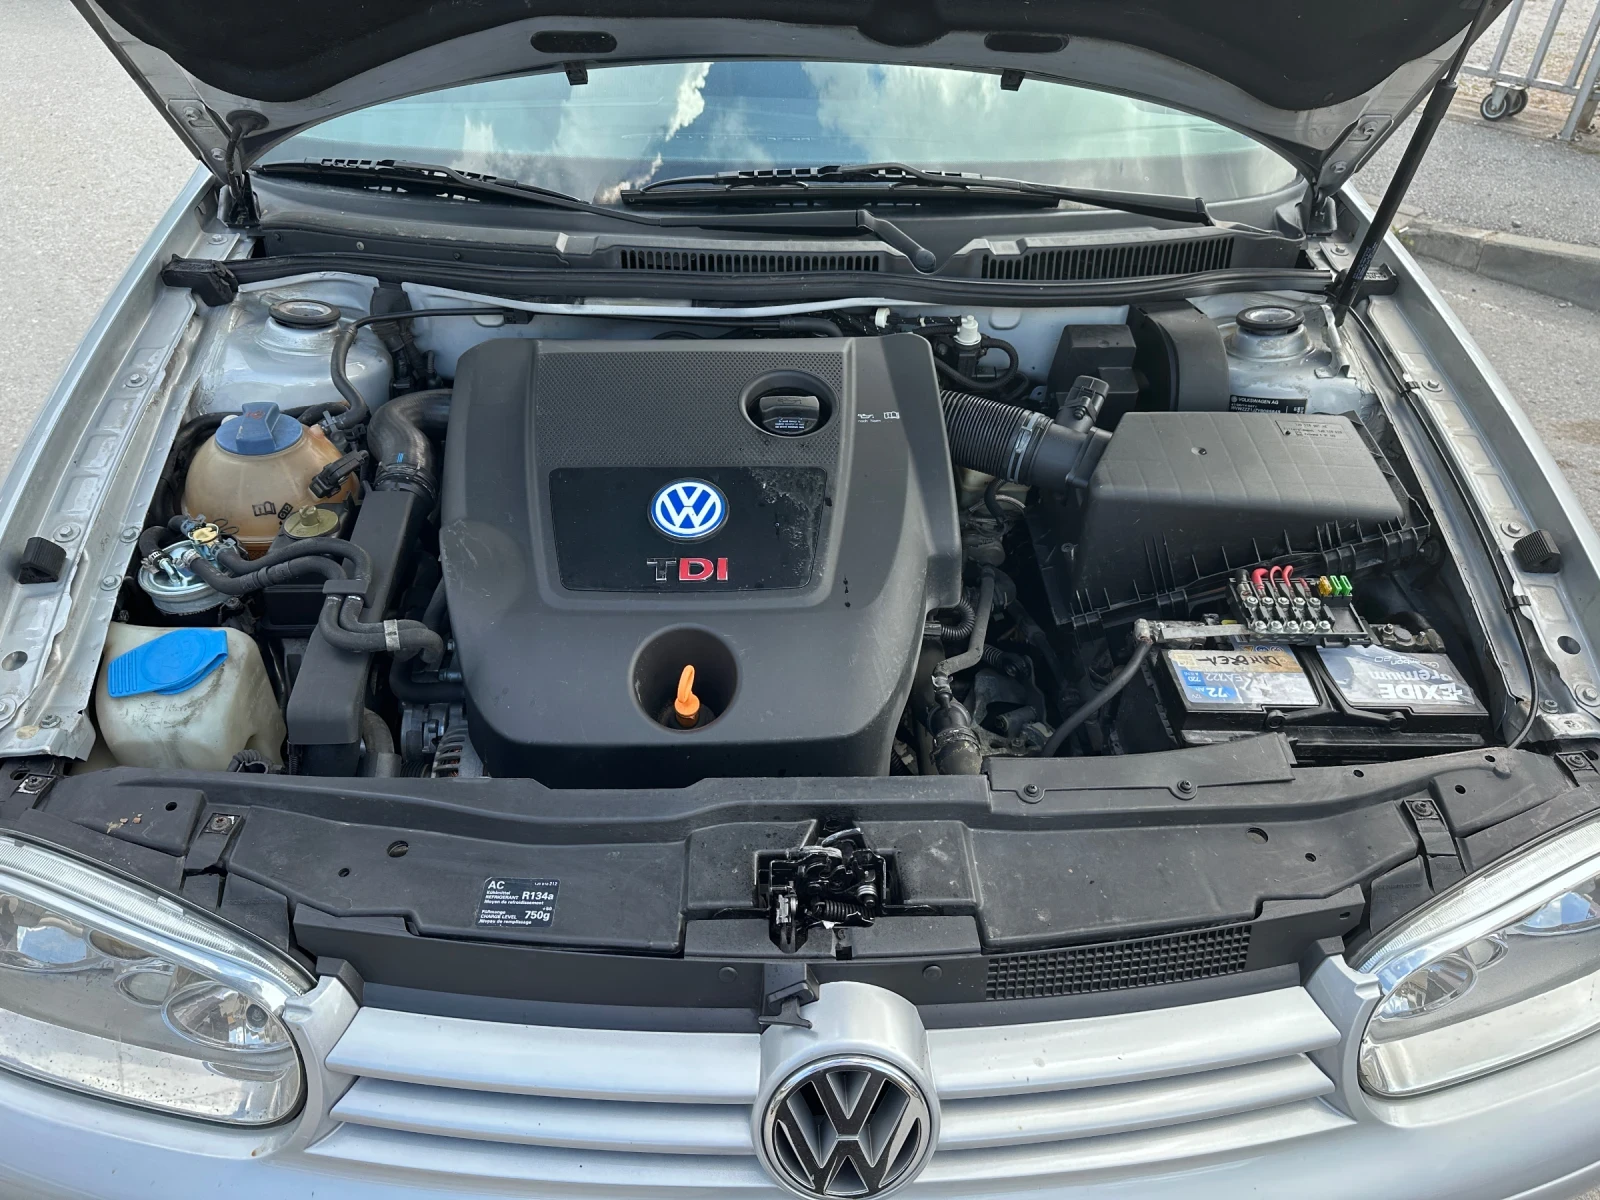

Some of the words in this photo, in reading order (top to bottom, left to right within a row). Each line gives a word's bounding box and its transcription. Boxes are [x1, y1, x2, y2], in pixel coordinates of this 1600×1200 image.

[1238, 397, 1270, 405] VOLKSWAGEN
[279, 503, 292, 519] G12
[652, 480, 725, 537] VW
[646, 557, 728, 581] TDI
[1205, 687, 1229, 698] 72
[1378, 683, 1462, 700] EXIDE
[488, 881, 505, 889] AC
[522, 891, 554, 900] R134a
[525, 911, 550, 921] 750g
